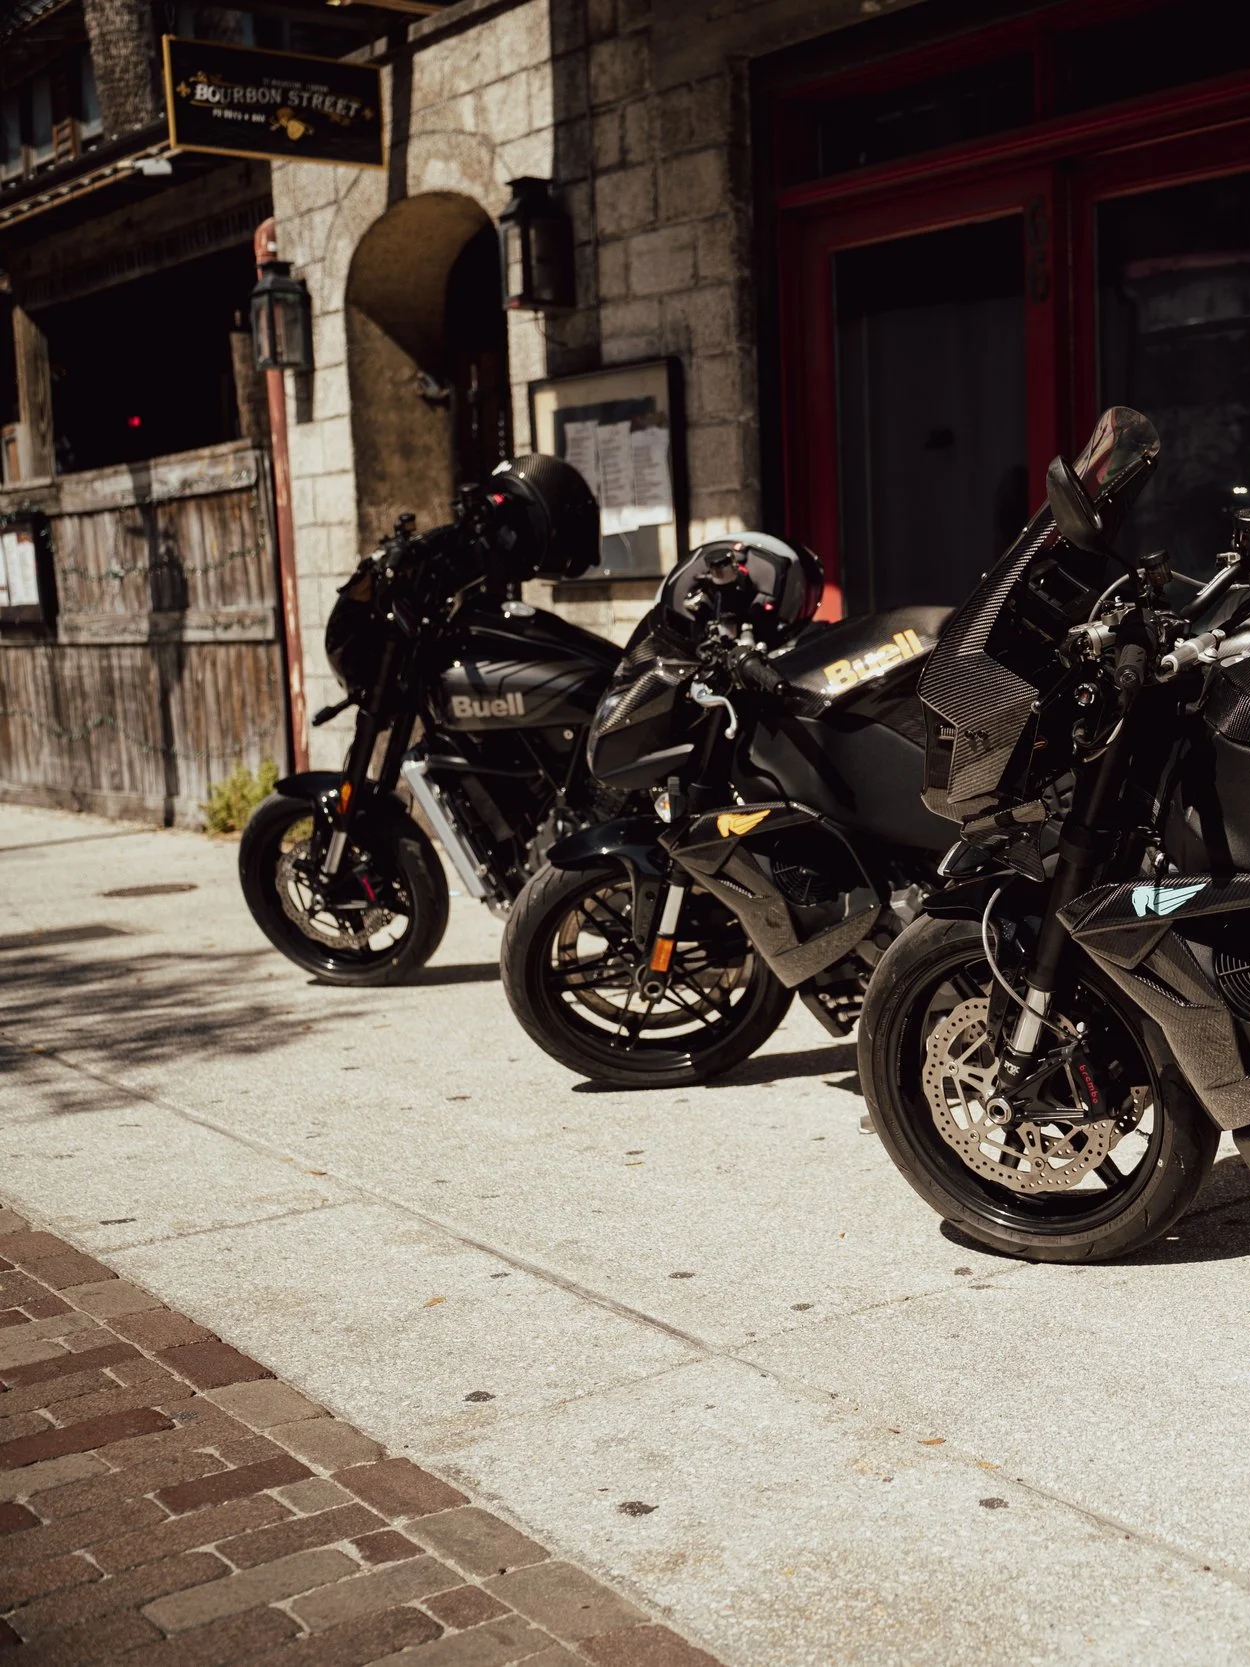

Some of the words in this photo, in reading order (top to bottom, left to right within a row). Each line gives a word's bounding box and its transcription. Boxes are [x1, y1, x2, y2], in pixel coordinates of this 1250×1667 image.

[194, 82, 282, 105] BOURBON
[287, 90, 362, 118] STREET
[823, 629, 925, 695] Buell
[451, 691, 526, 719] Buell
[1078, 1063, 1099, 1104] brembo
